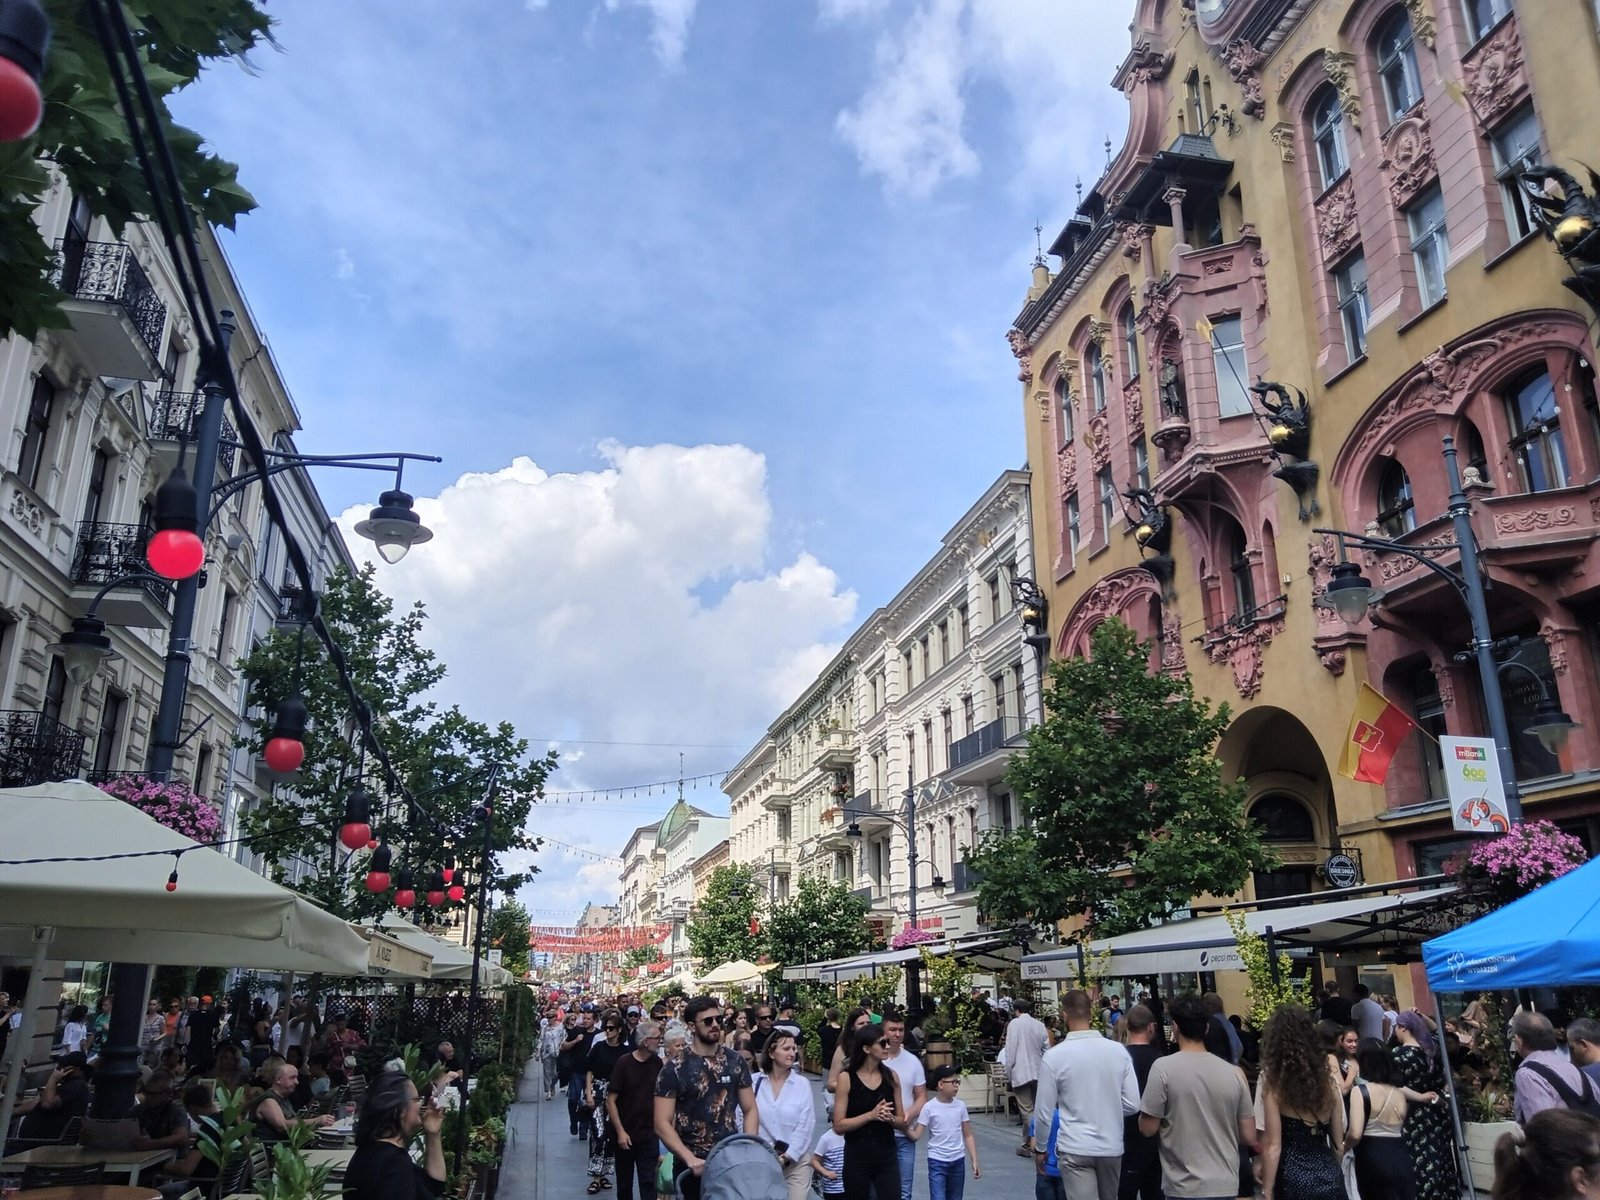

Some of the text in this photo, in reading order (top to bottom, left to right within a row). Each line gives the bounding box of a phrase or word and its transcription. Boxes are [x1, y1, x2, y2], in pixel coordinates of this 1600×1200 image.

[1458, 750, 1483, 758] mBank
[1210, 954, 1226, 963] pepsi
[1488, 955, 1517, 964] CENTRUM
